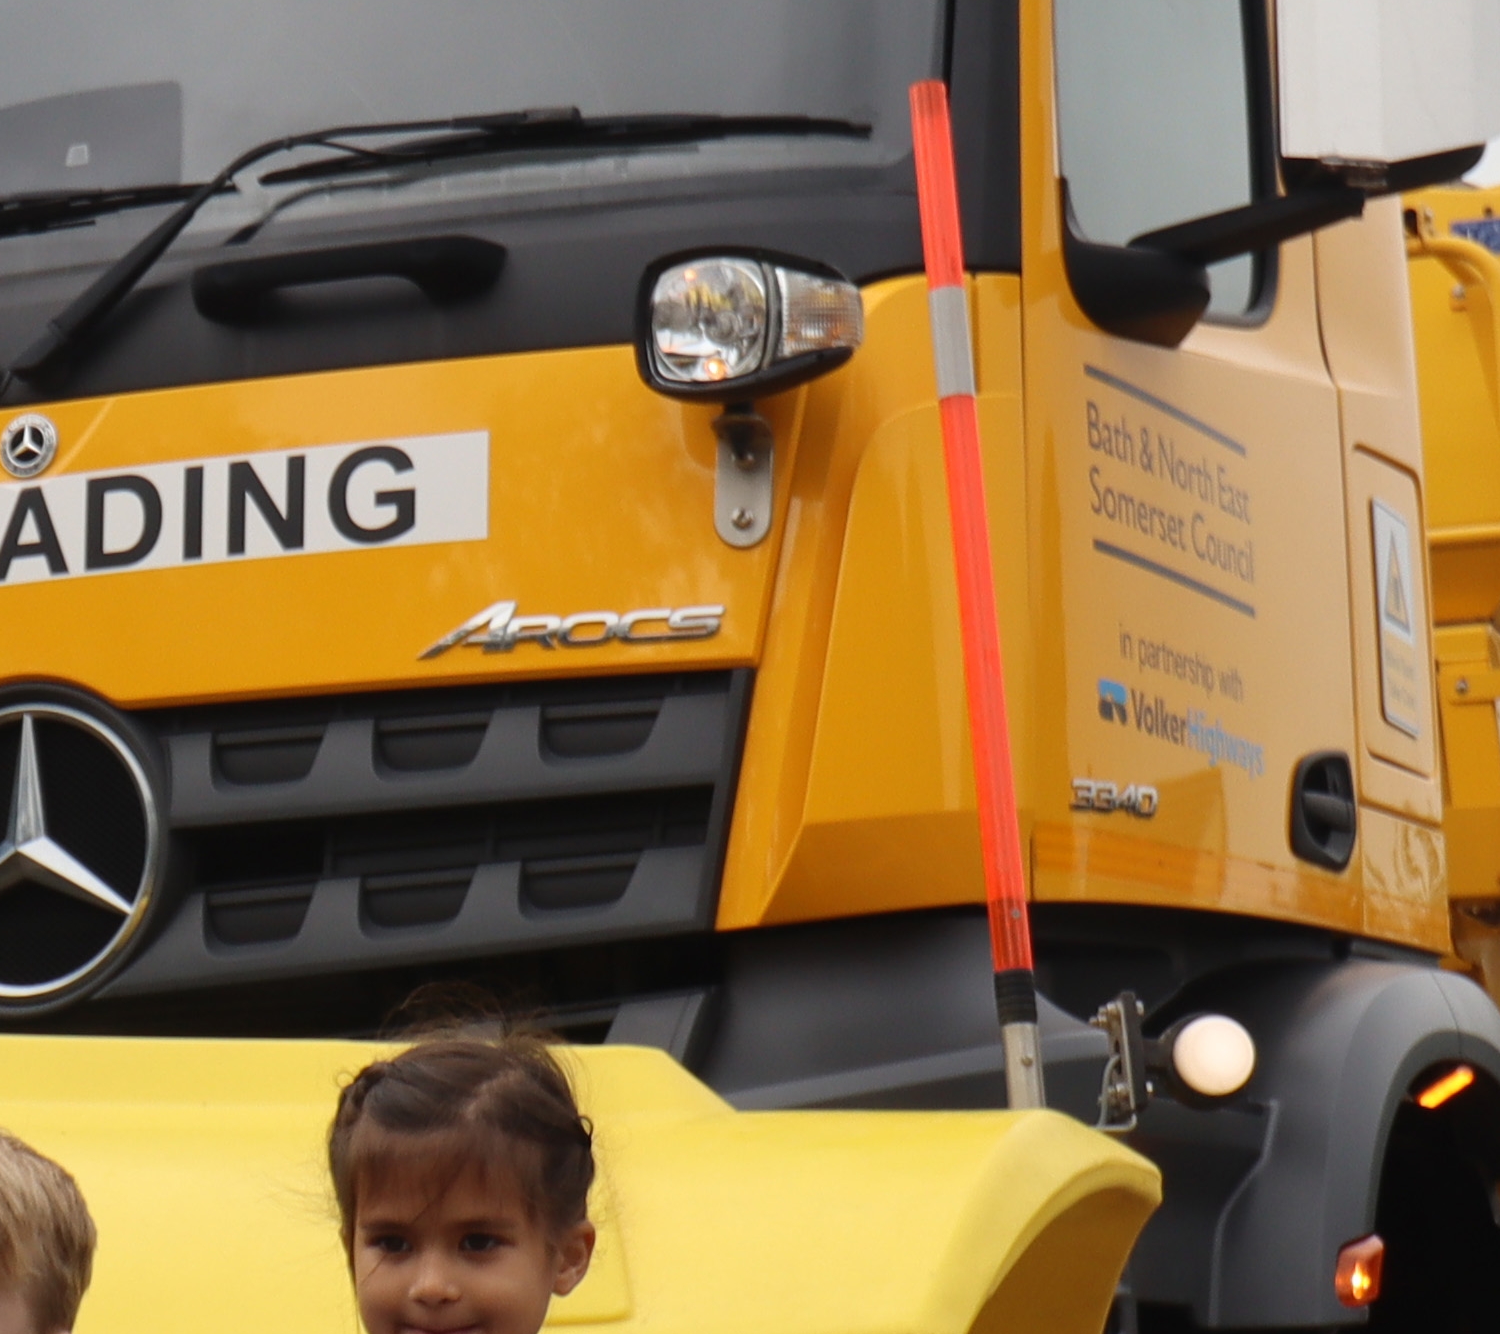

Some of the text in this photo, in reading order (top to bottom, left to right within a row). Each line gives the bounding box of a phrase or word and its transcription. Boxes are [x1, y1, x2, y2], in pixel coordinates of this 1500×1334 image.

[1086, 401, 1250, 525] Bath & North East
[1089, 466, 1256, 584] Somerset Council
[1118, 623, 1132, 661] in
[1137, 632, 1214, 695] partnership
[1133, 691, 1265, 779] VolkerHighways
[1070, 778, 1158, 818] 3340
